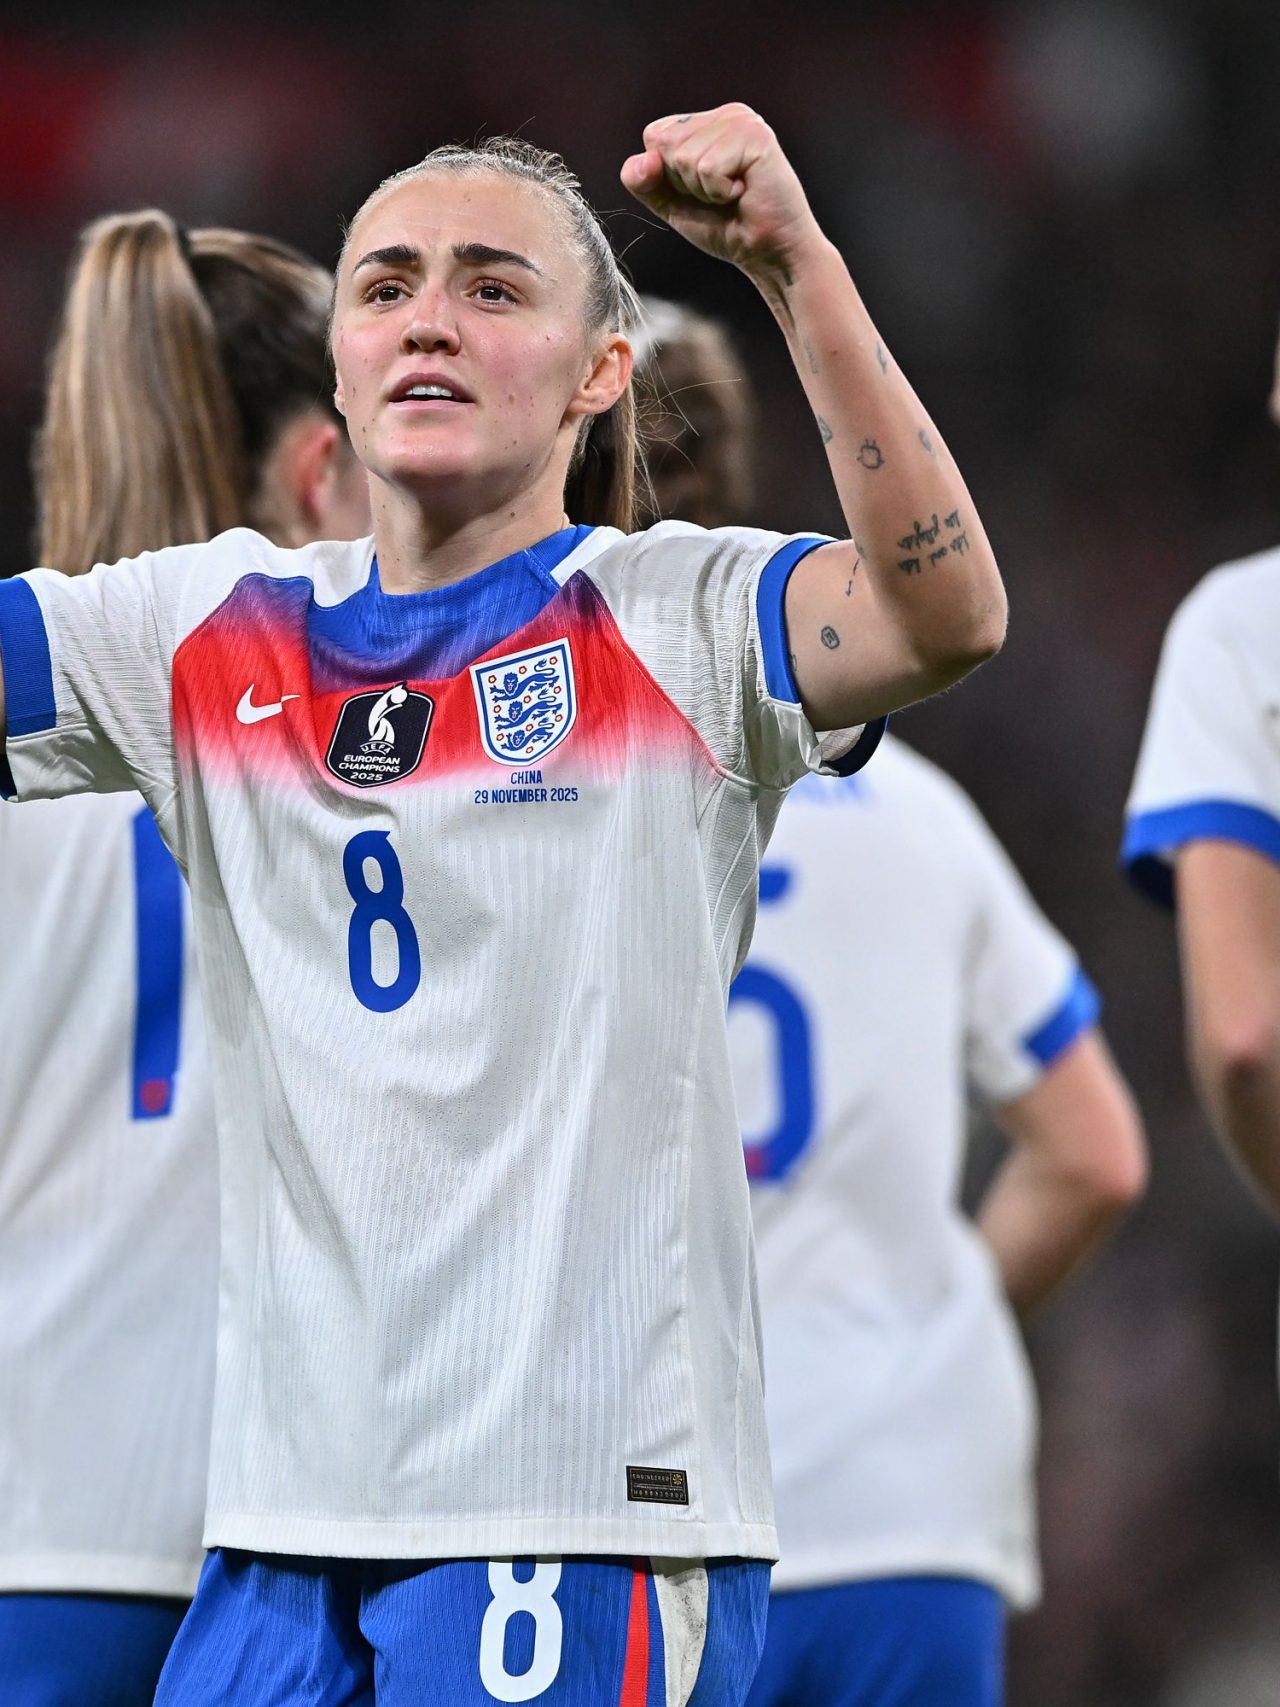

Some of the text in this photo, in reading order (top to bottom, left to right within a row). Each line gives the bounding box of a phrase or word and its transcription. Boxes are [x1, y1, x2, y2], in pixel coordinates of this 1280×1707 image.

[361, 744, 392, 754] UEFA
[343, 754, 401, 765] EUROPEAN
[338, 762, 401, 773] CHAMPIONS
[350, 771, 384, 781] 2025
[510, 770, 543, 784] CHINA
[474, 787, 579, 804] 29 NOVEMBER 2025
[342, 829, 422, 1014] 8
[478, 1554, 563, 1703] 8
